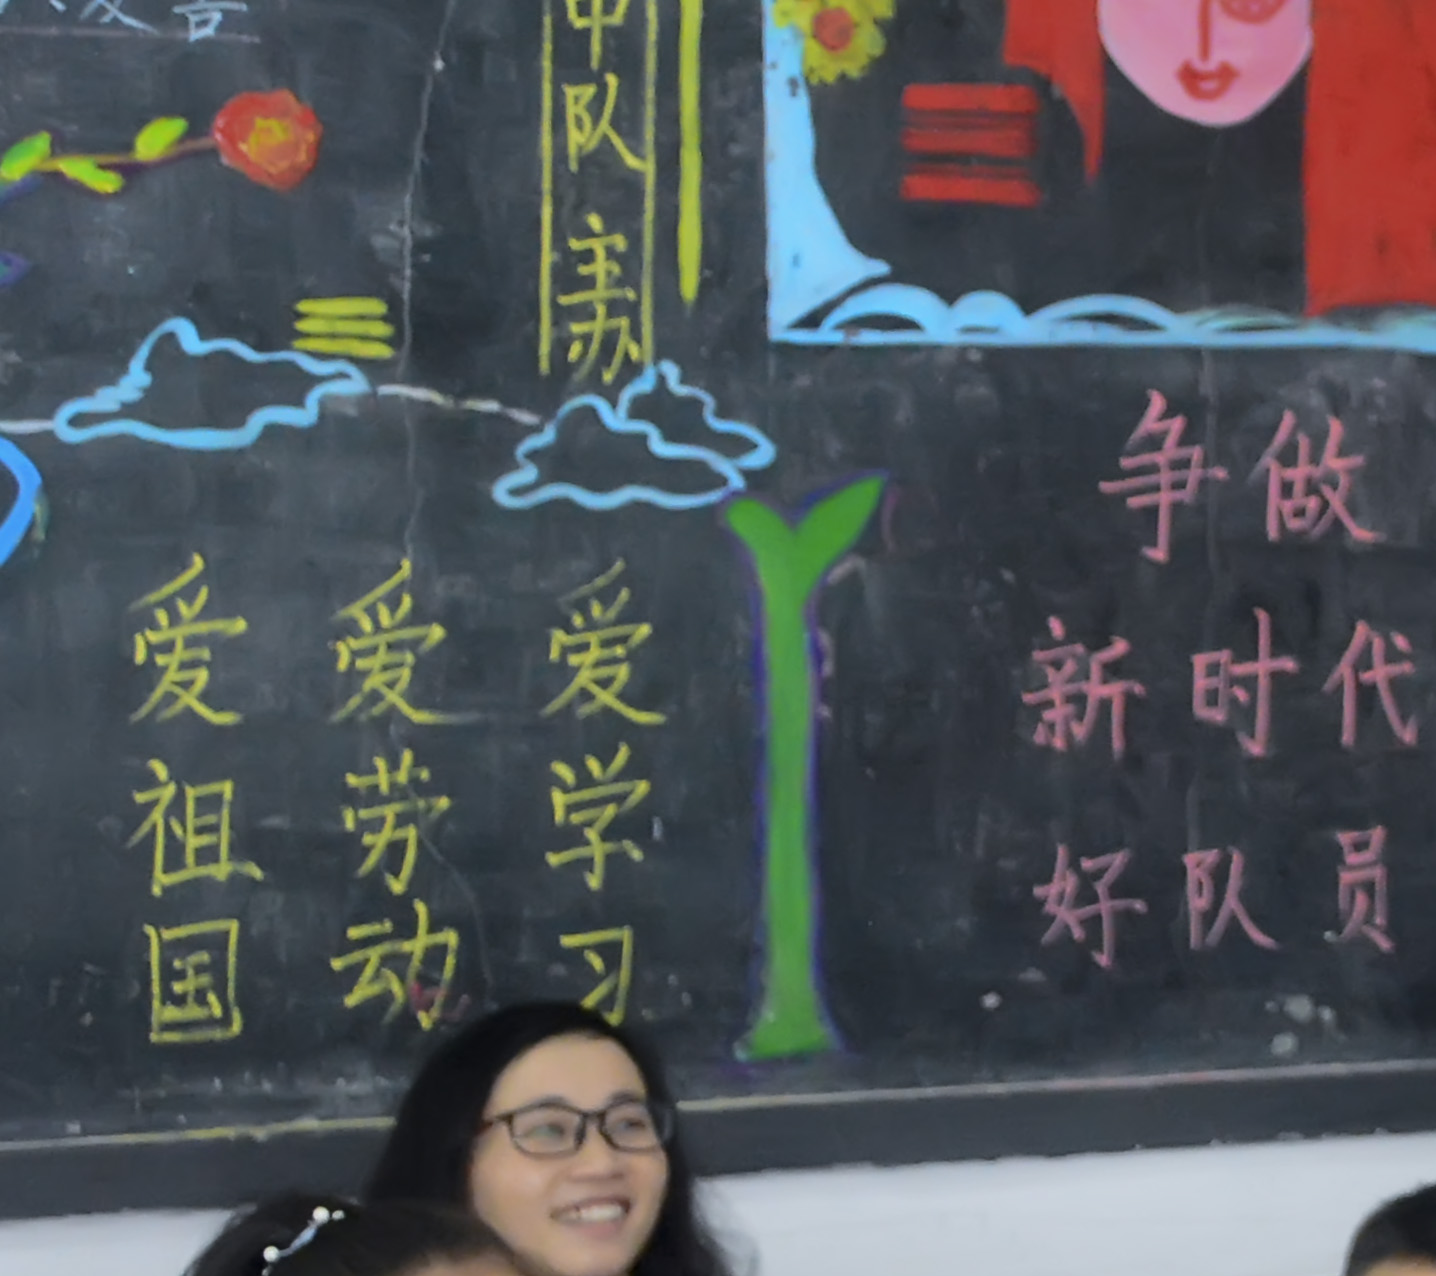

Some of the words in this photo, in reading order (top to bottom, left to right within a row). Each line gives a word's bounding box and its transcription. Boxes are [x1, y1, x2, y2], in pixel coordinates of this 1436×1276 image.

[1099, 388, 1387, 563] 争做
[126, 552, 264, 1043] 爱祖国
[328, 557, 468, 1031] 爱劳动
[539, 557, 667, 1027] 爱学习
[1021, 606, 1420, 760] 新时代
[1032, 823, 1396, 968] 好队员
